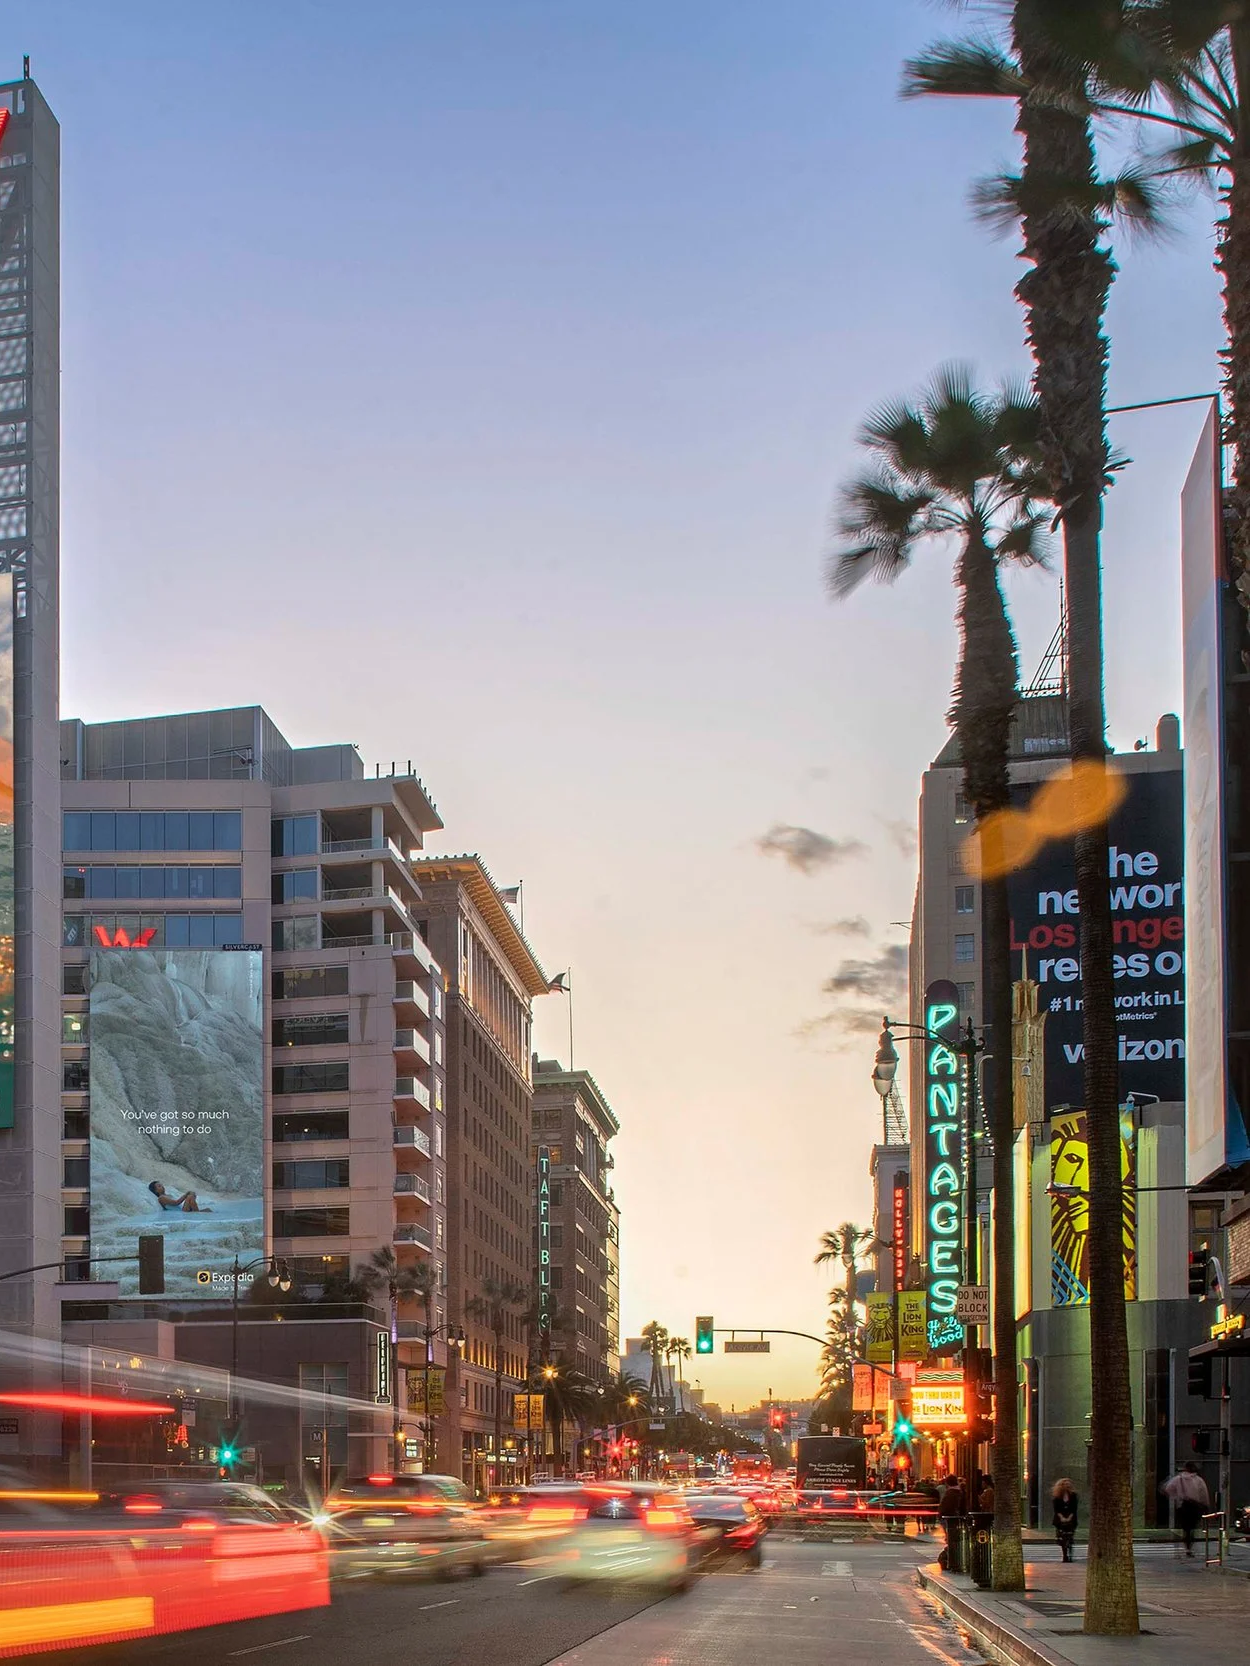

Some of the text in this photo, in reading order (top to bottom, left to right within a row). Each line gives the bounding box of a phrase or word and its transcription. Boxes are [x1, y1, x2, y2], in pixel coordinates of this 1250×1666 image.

[1108, 846, 1159, 878] he
[1009, 917, 1076, 951] Los
[1154, 951, 1184, 976] o
[1050, 996, 1071, 1012] #1
[1154, 991, 1171, 1006] in
[1063, 1035, 1184, 1064] vizon
[120, 1109, 229, 1122] You've got so much
[138, 1124, 212, 1136] nothing to do
[928, 1004, 959, 1313] PANTAGES
[540, 1158, 549, 1236] TAFT
[959, 1291, 988, 1300] DO NOT
[958, 1303, 988, 1312] BLOCK
[903, 1312, 922, 1323] LION
[901, 1324, 924, 1336] KING
[981, 1383, 996, 1391] Argy
[922, 1403, 943, 1415] LION
[944, 1403, 963, 1415] KIN
